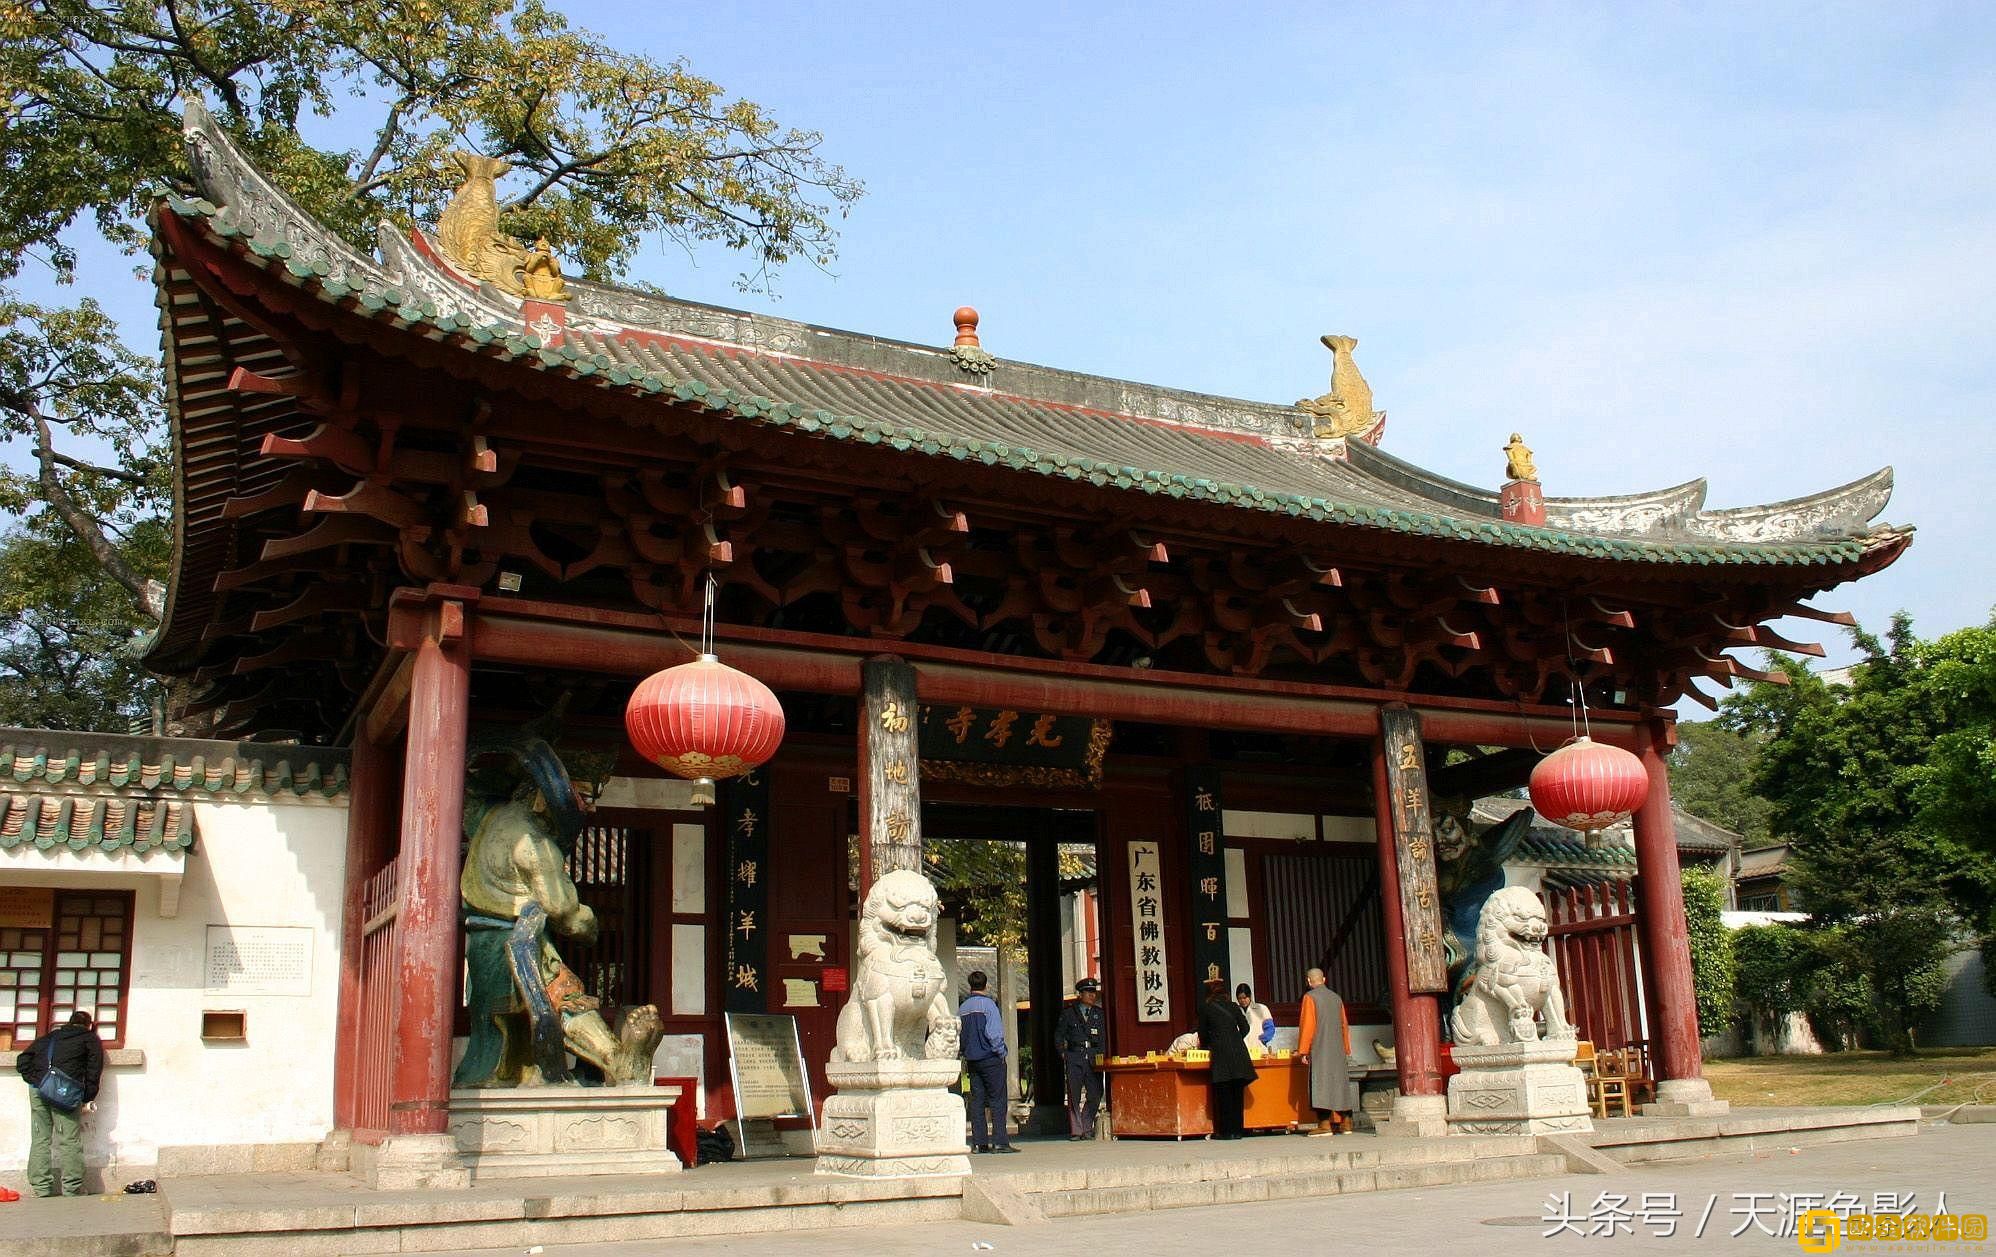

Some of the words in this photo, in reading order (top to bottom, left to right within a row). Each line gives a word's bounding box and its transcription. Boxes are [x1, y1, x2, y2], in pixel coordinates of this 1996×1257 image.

[881, 703, 913, 870] 初地訪
[1134, 847, 1164, 1017] 广东省佛教协会
